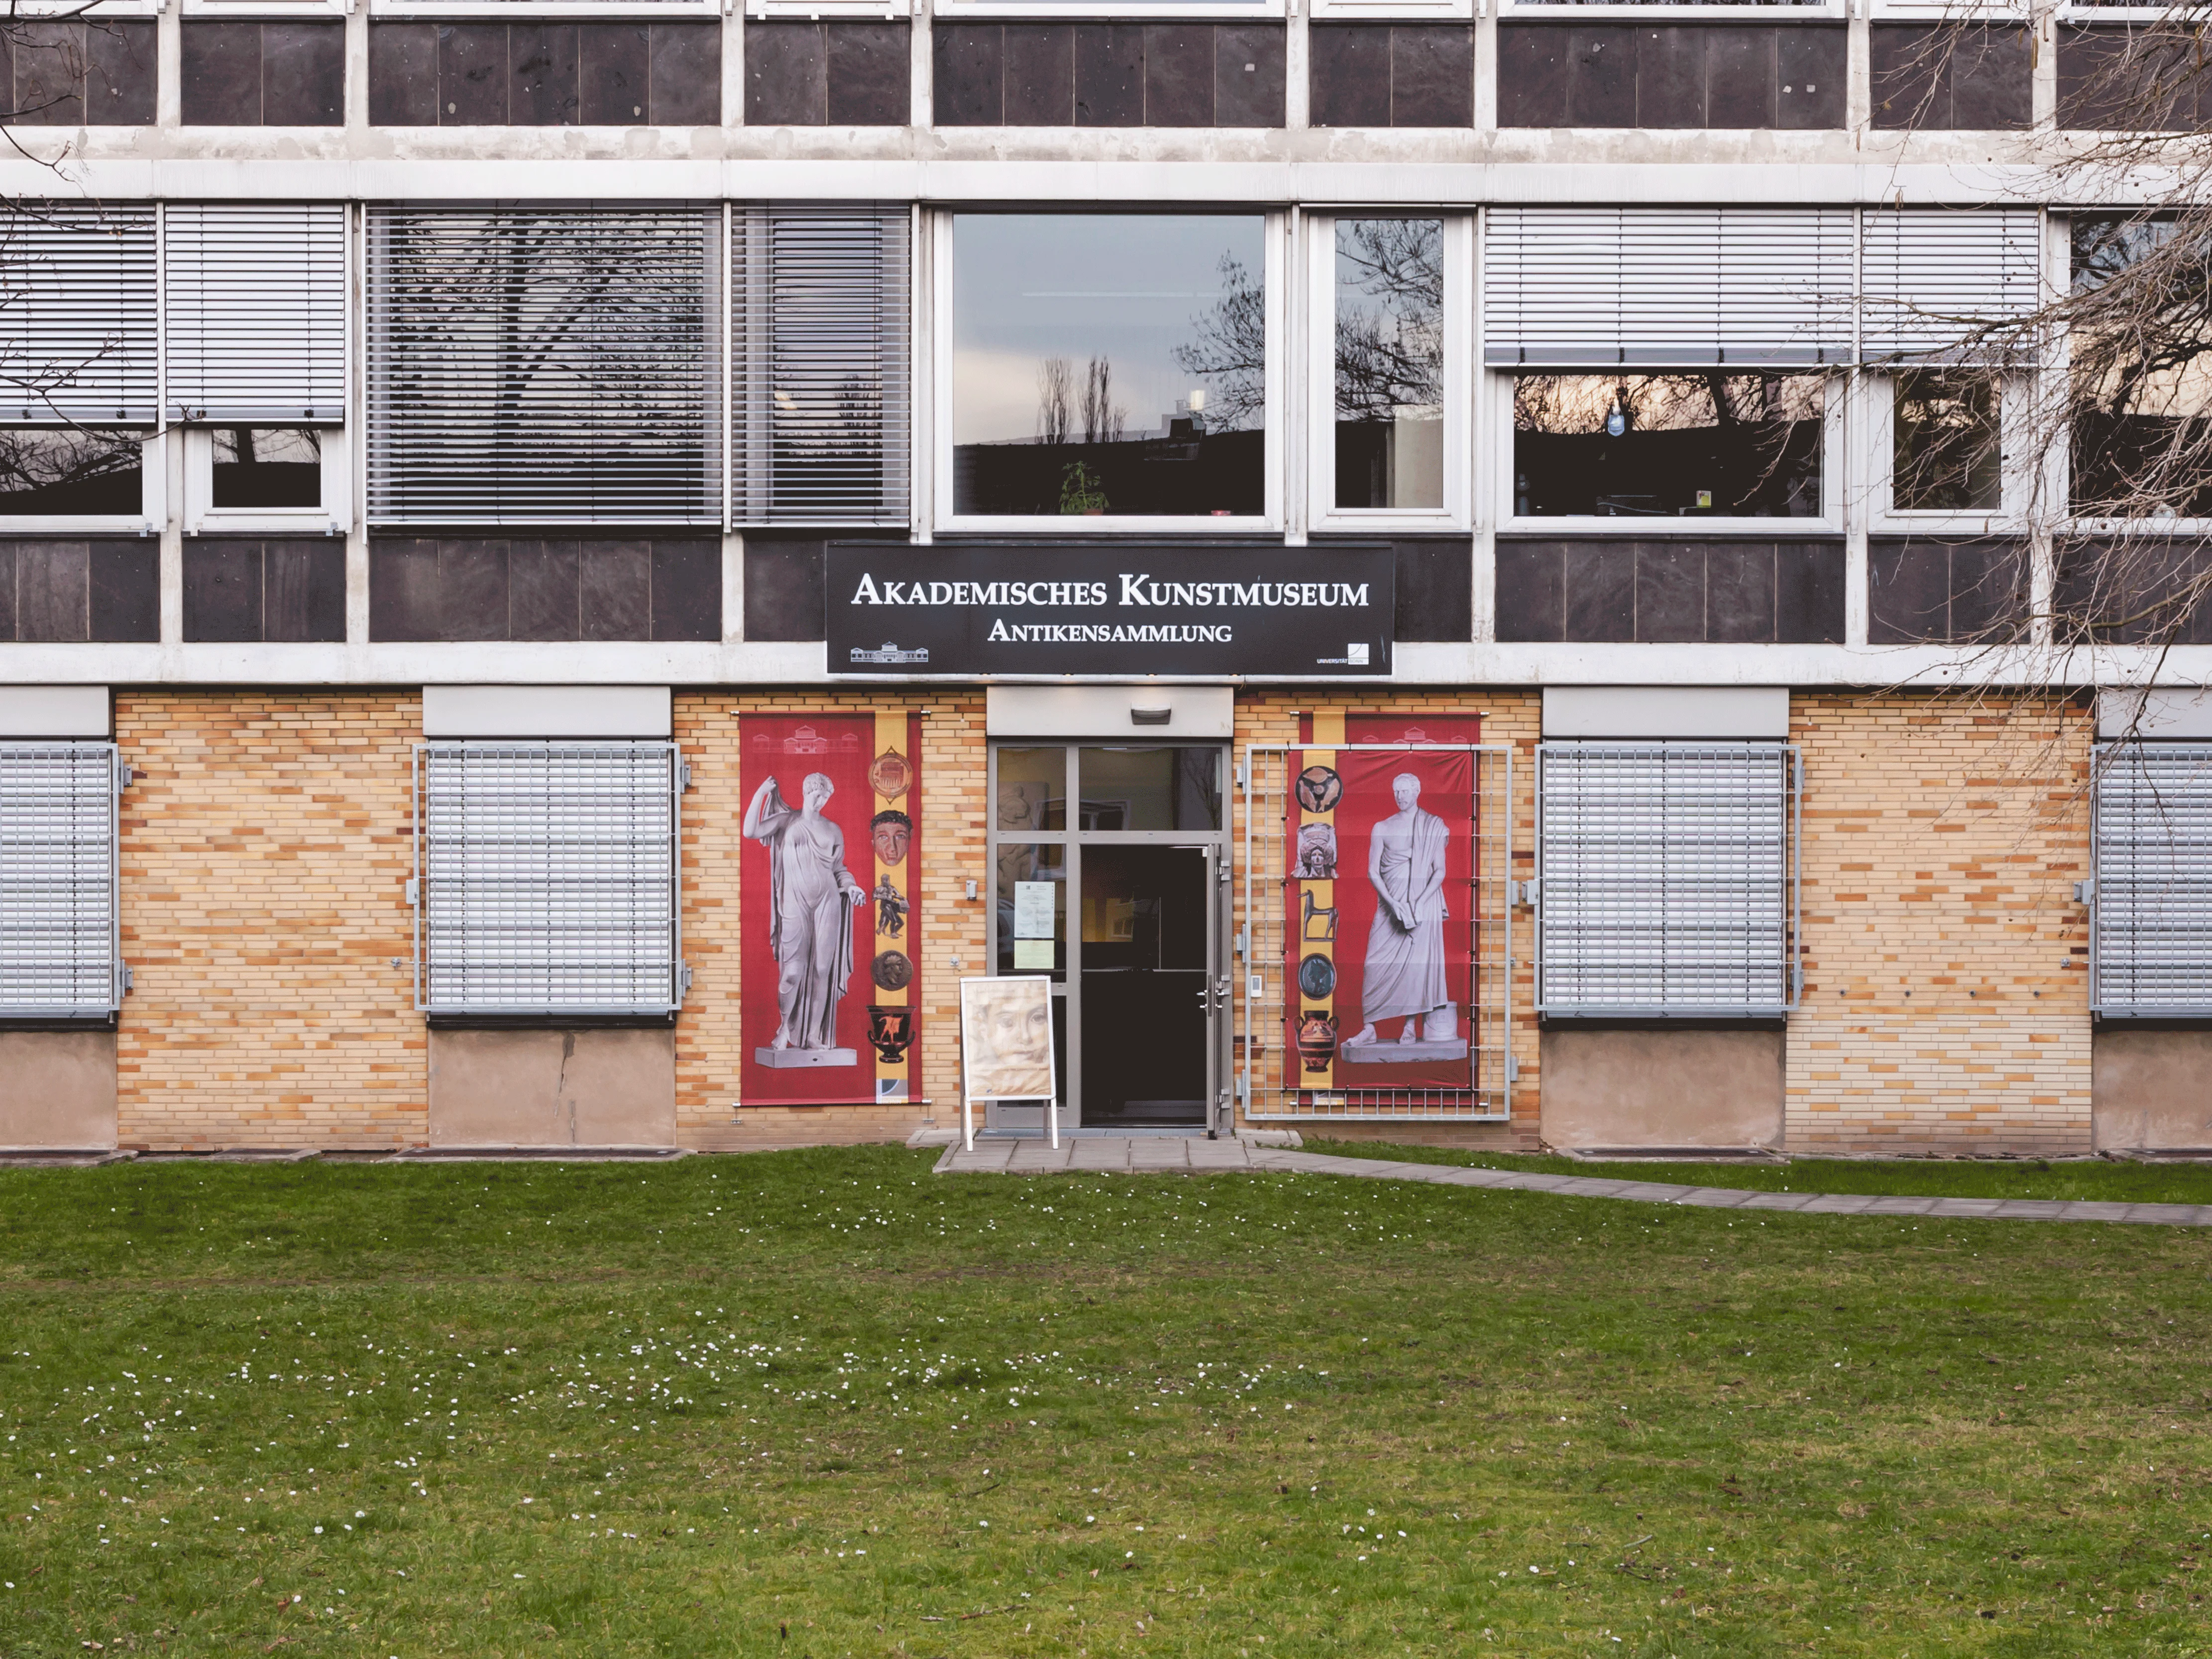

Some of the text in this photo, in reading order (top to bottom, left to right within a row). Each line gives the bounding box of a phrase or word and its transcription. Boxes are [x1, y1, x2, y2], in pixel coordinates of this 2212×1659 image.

[851, 573, 1369, 606] AKADEMISCHES KUNSTMUSEUM
[987, 618, 1232, 642] ANTIKENSAMMLUNG
